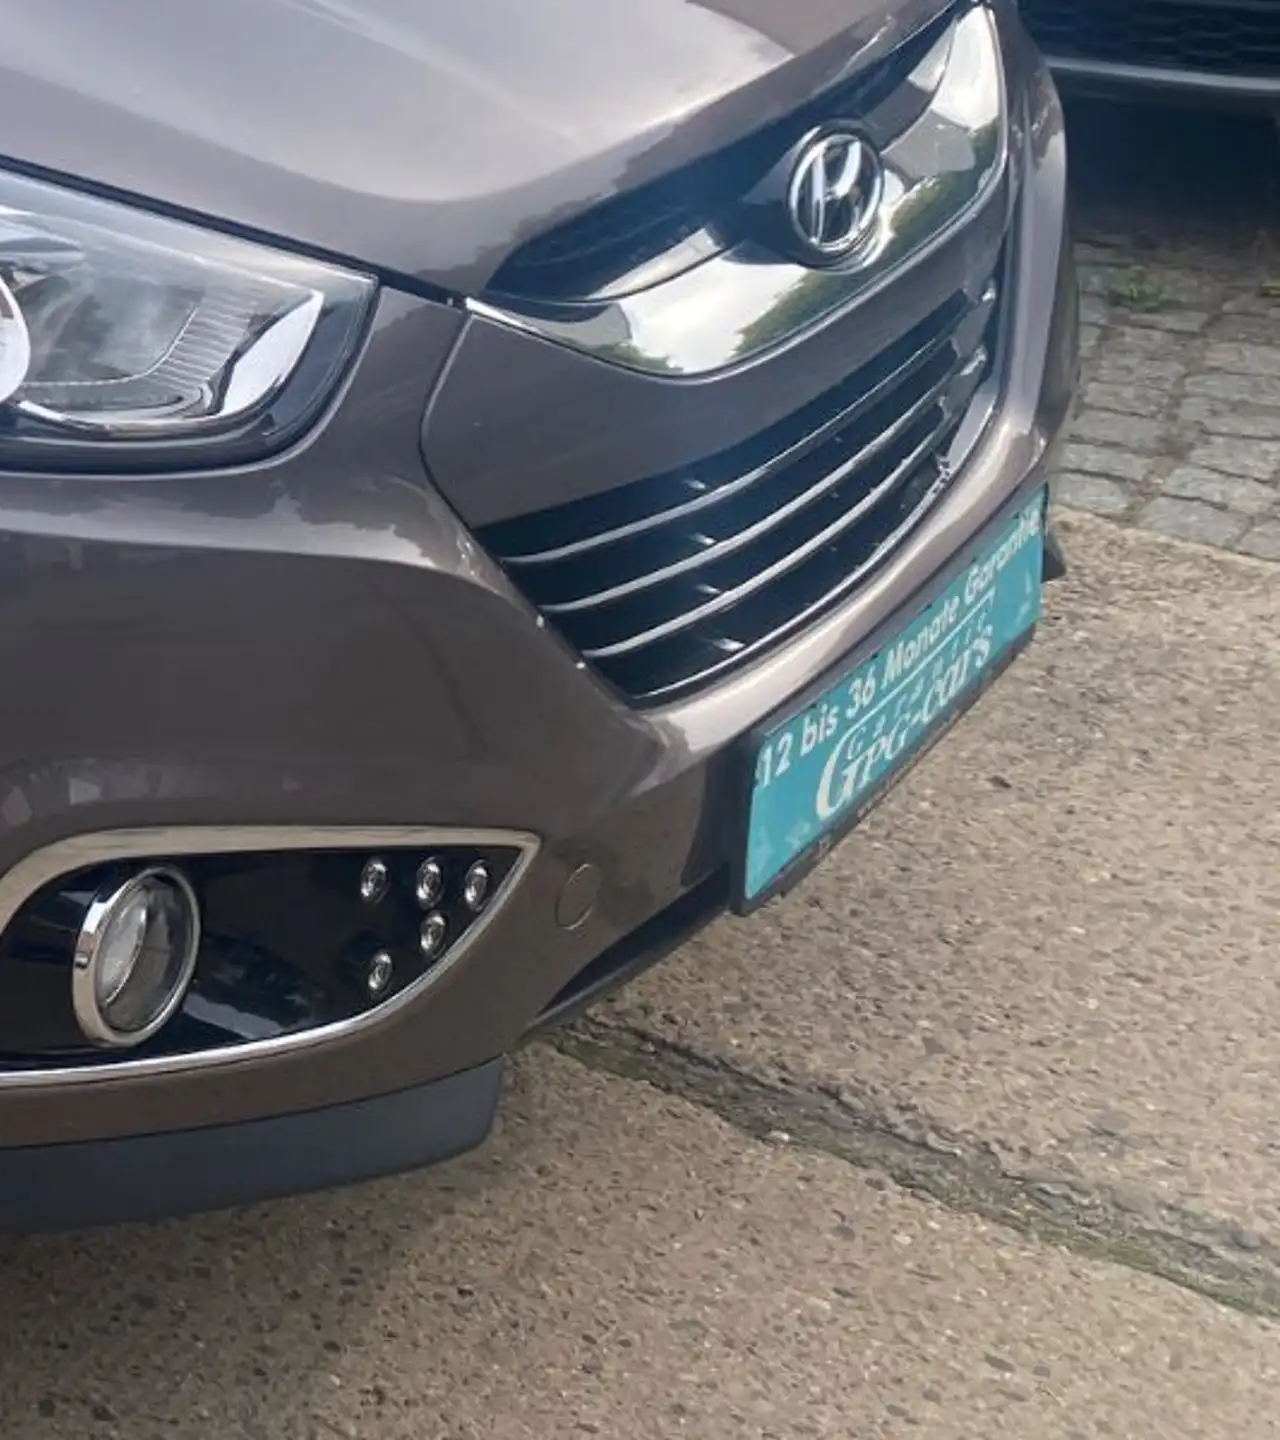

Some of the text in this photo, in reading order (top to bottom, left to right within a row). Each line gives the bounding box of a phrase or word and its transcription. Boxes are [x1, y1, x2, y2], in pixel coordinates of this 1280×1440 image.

[755, 731, 794, 788] 12
[799, 702, 840, 757] bis
[845, 663, 876, 720] 36
[880, 594, 961, 691] Monate
